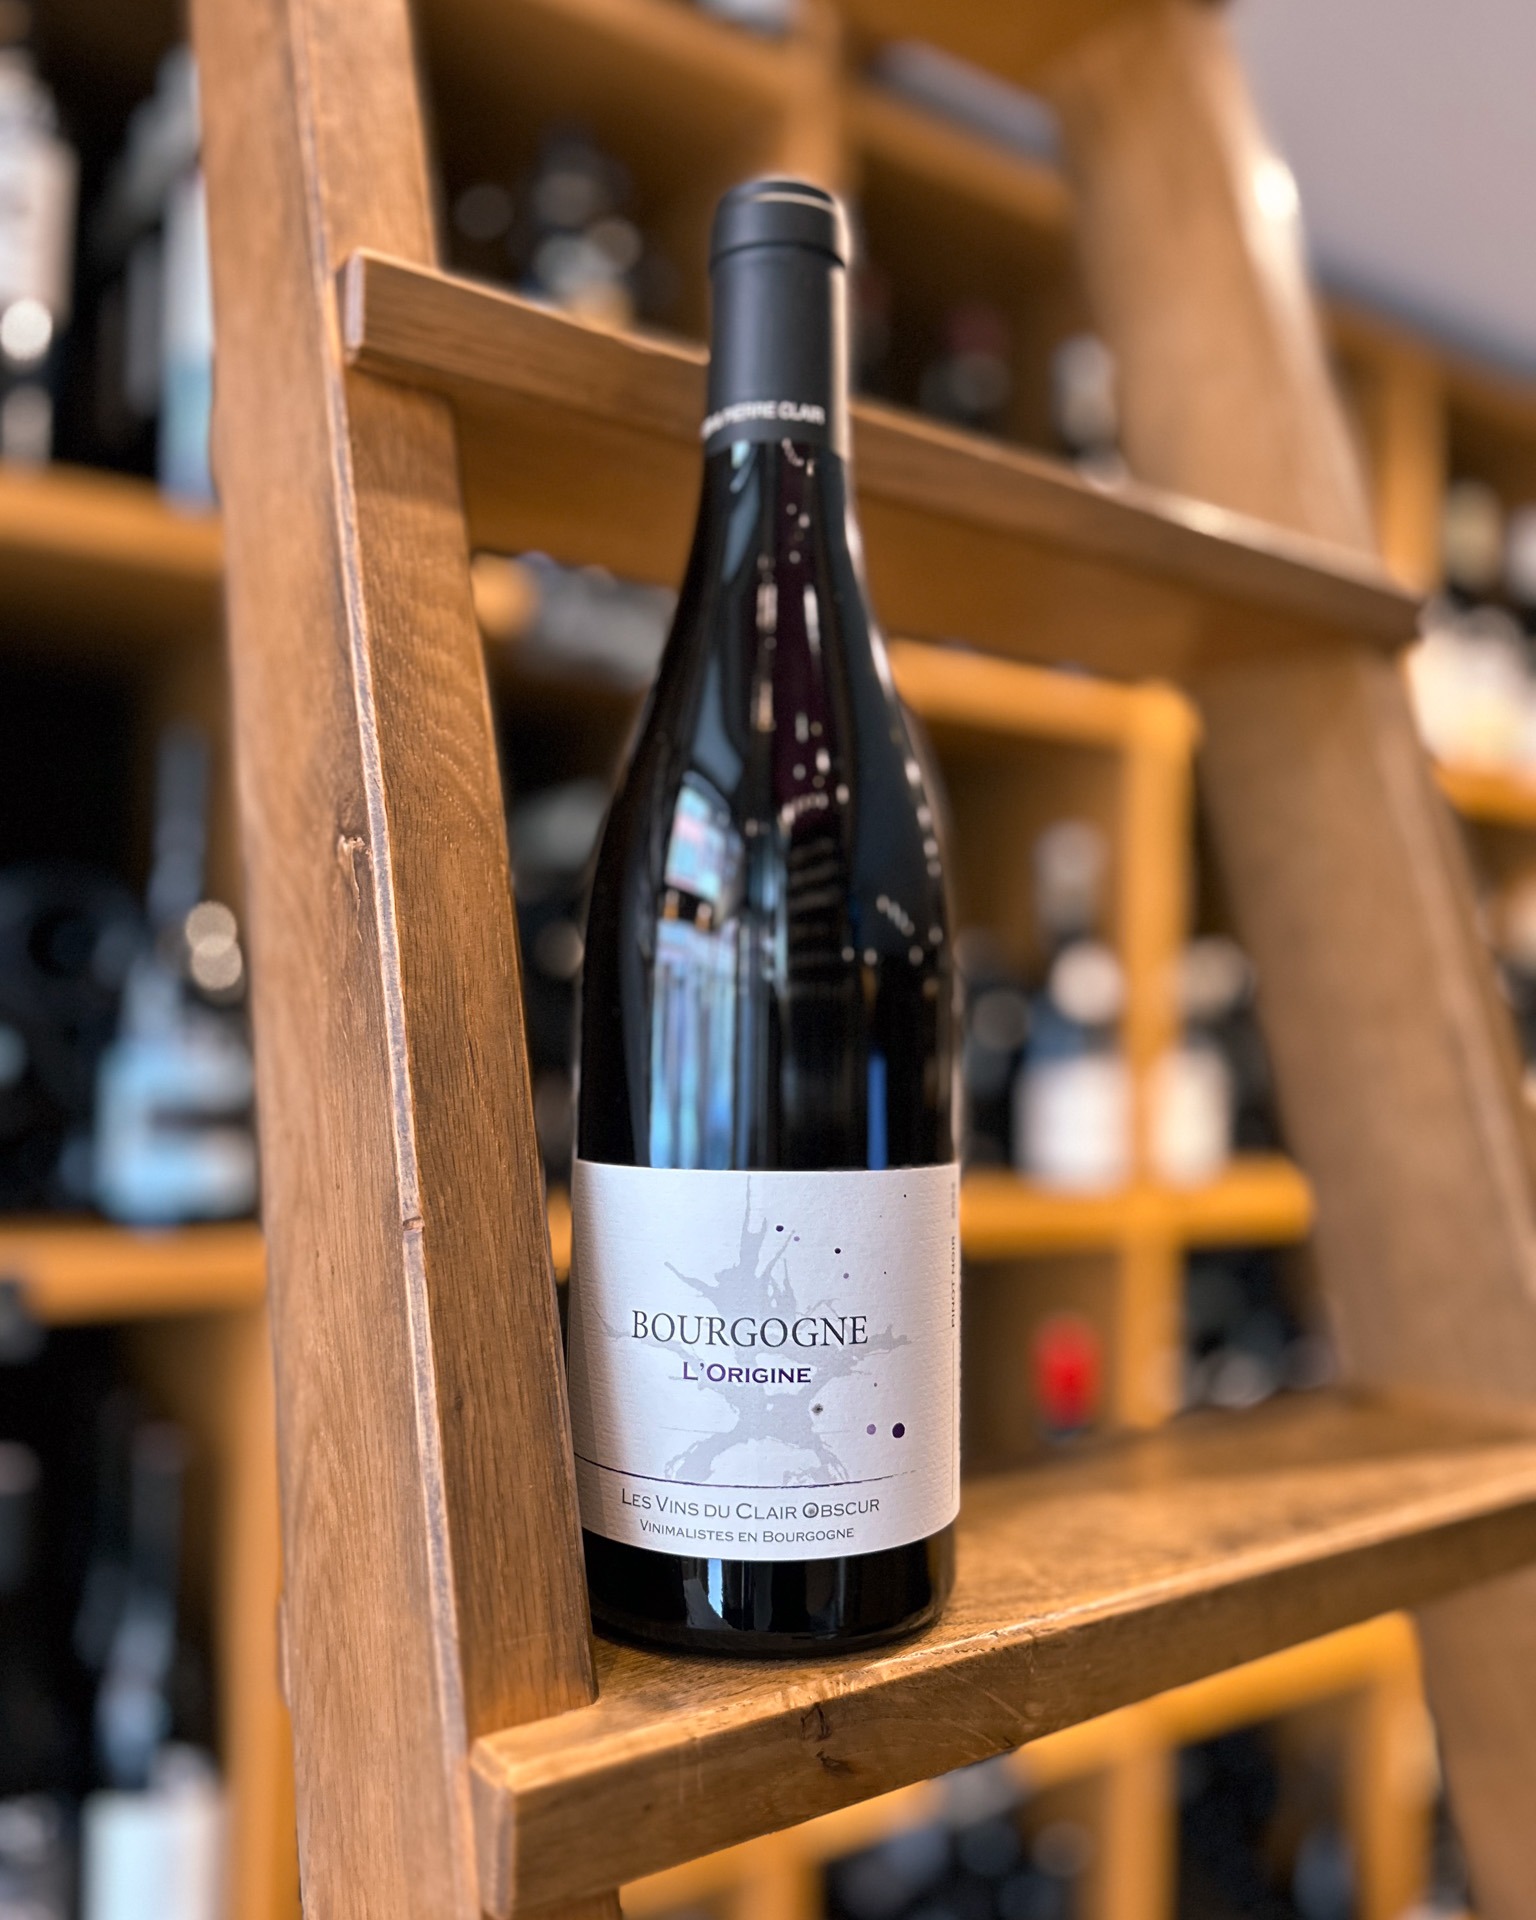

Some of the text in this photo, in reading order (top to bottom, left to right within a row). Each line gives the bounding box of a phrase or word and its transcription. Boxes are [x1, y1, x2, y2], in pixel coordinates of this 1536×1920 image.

[632, 1309, 869, 1348] BOURGOGNE
[682, 1361, 812, 1384] L'ORIGINE
[622, 1488, 880, 1520] LES VINS DU CLAIR OBSCUR
[640, 1519, 855, 1542] VINIMALISTES EN BOURGOGNE
